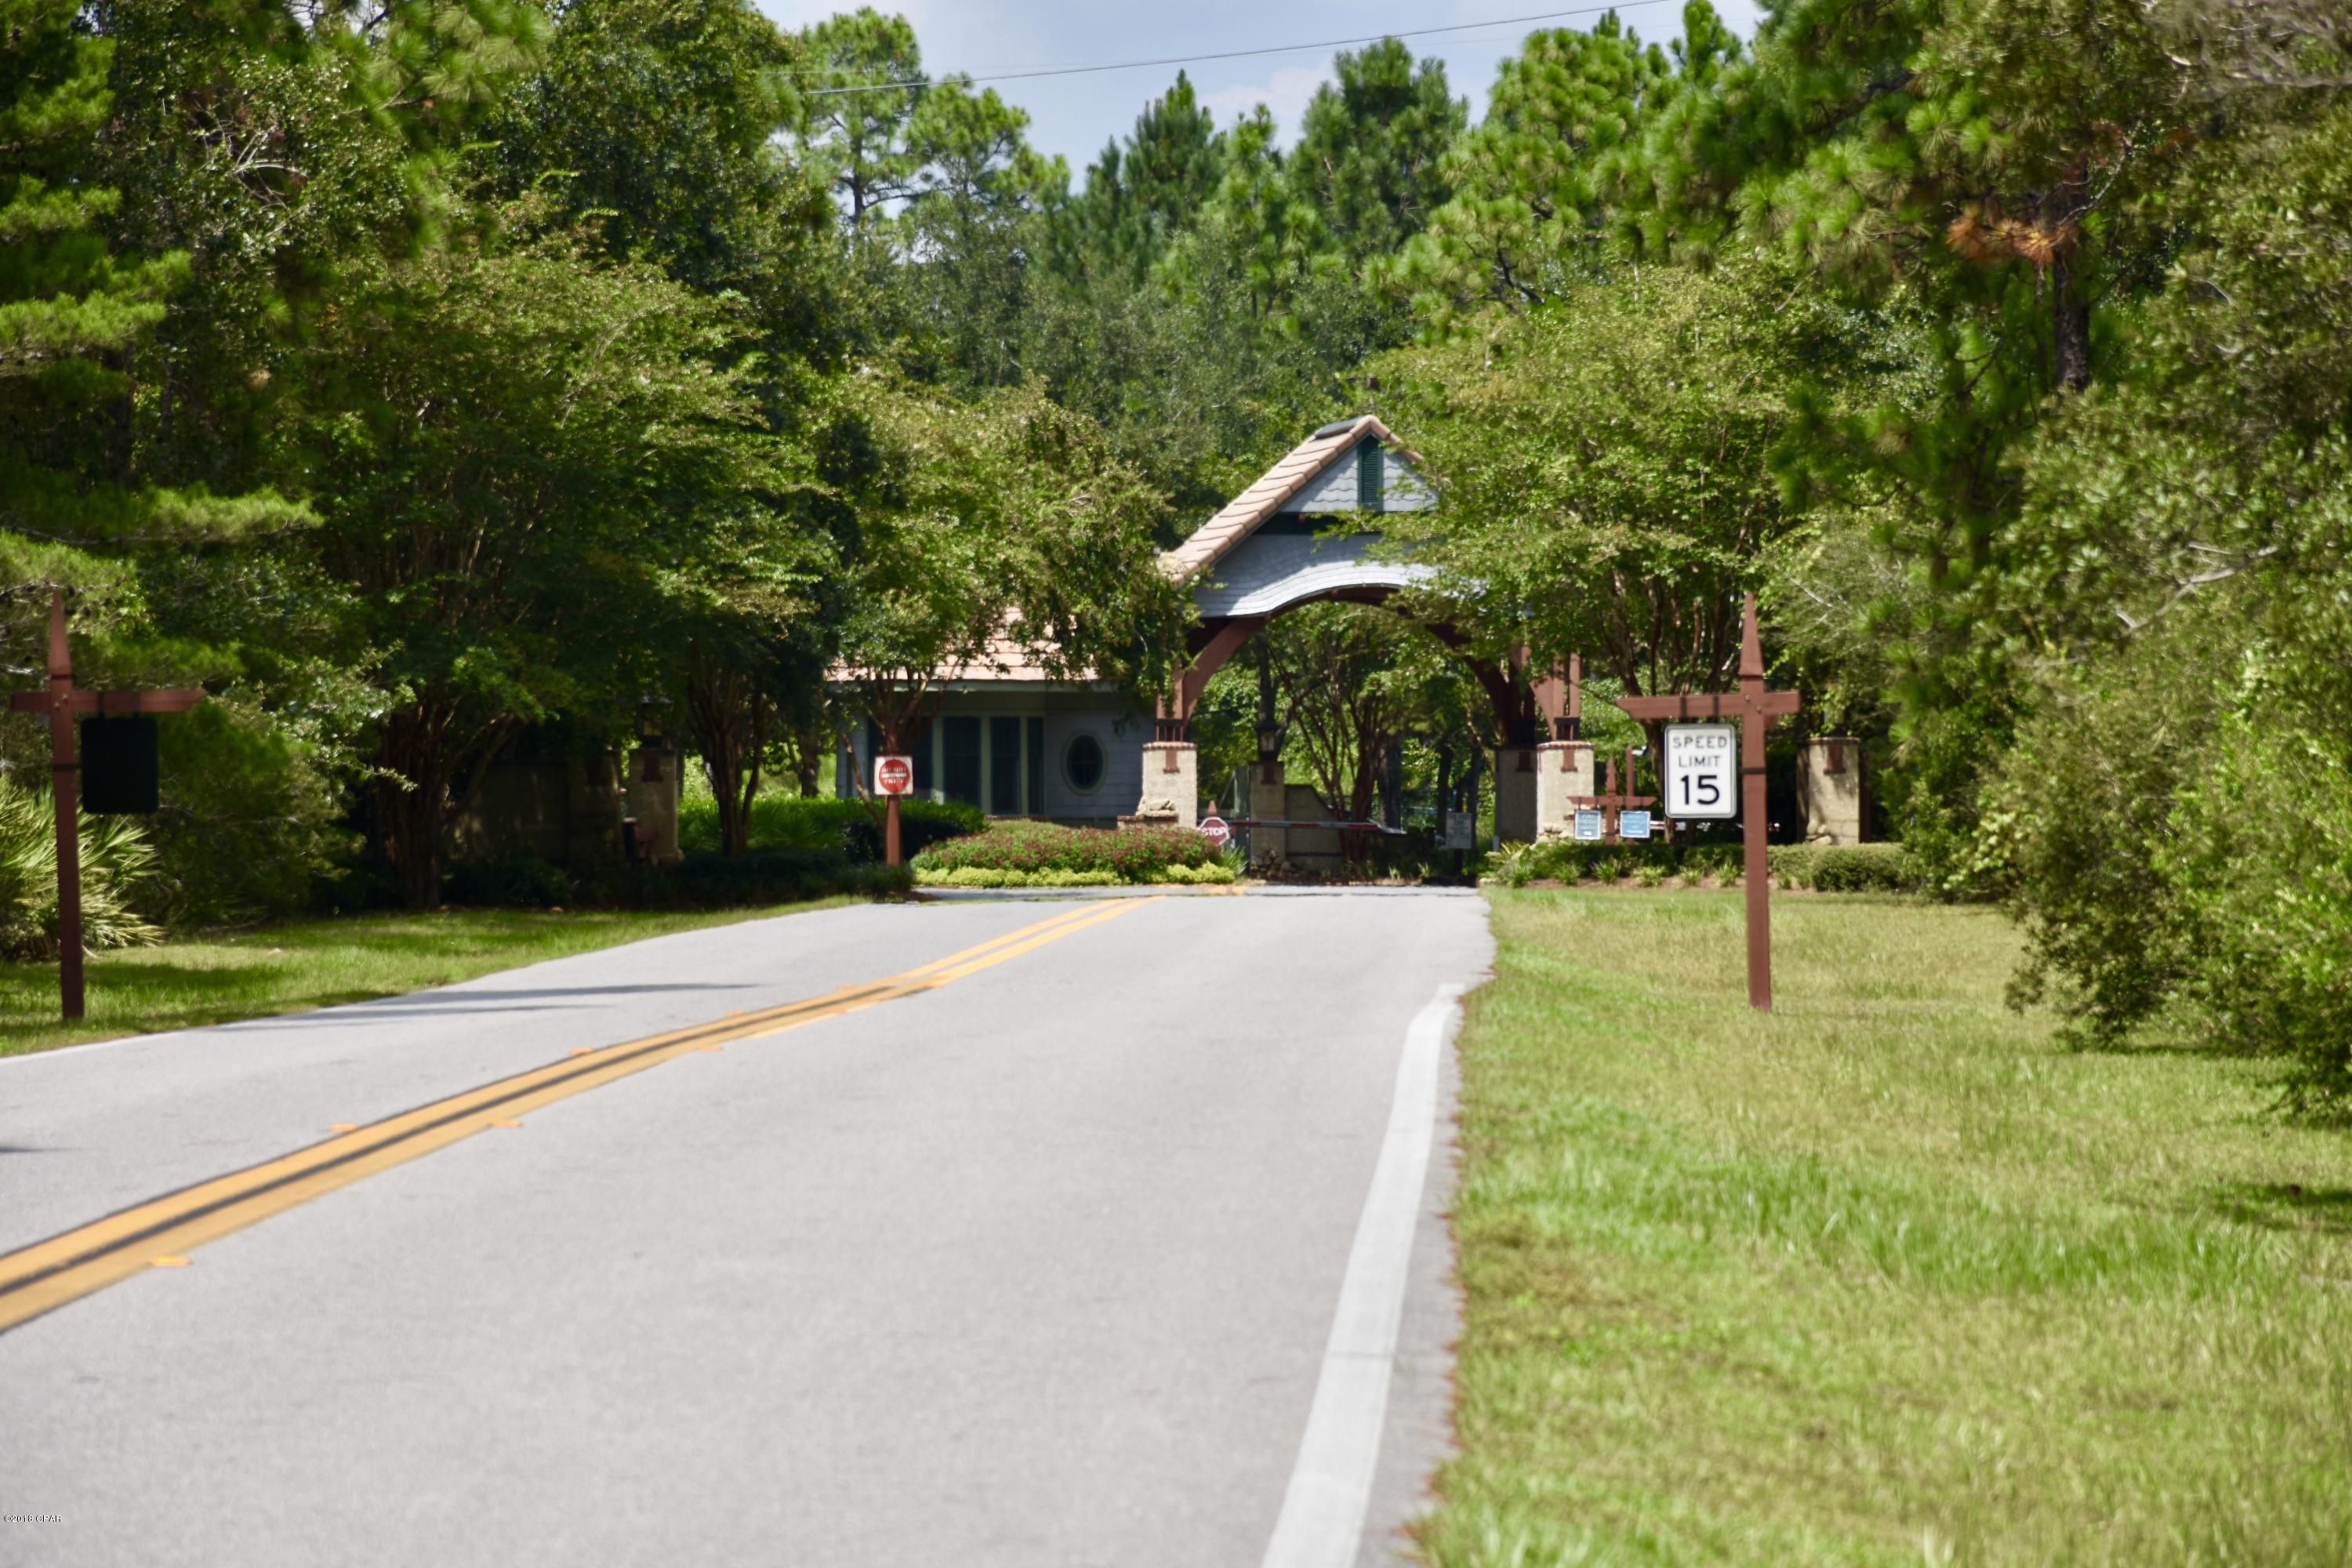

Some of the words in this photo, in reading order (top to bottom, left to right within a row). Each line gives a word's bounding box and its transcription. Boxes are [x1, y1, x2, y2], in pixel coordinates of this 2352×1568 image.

[1672, 735, 1727, 750] SPEED
[1678, 755, 1721, 768] LIMIT
[1680, 775, 1720, 805] 15
[1201, 826, 1226, 837] STOP
